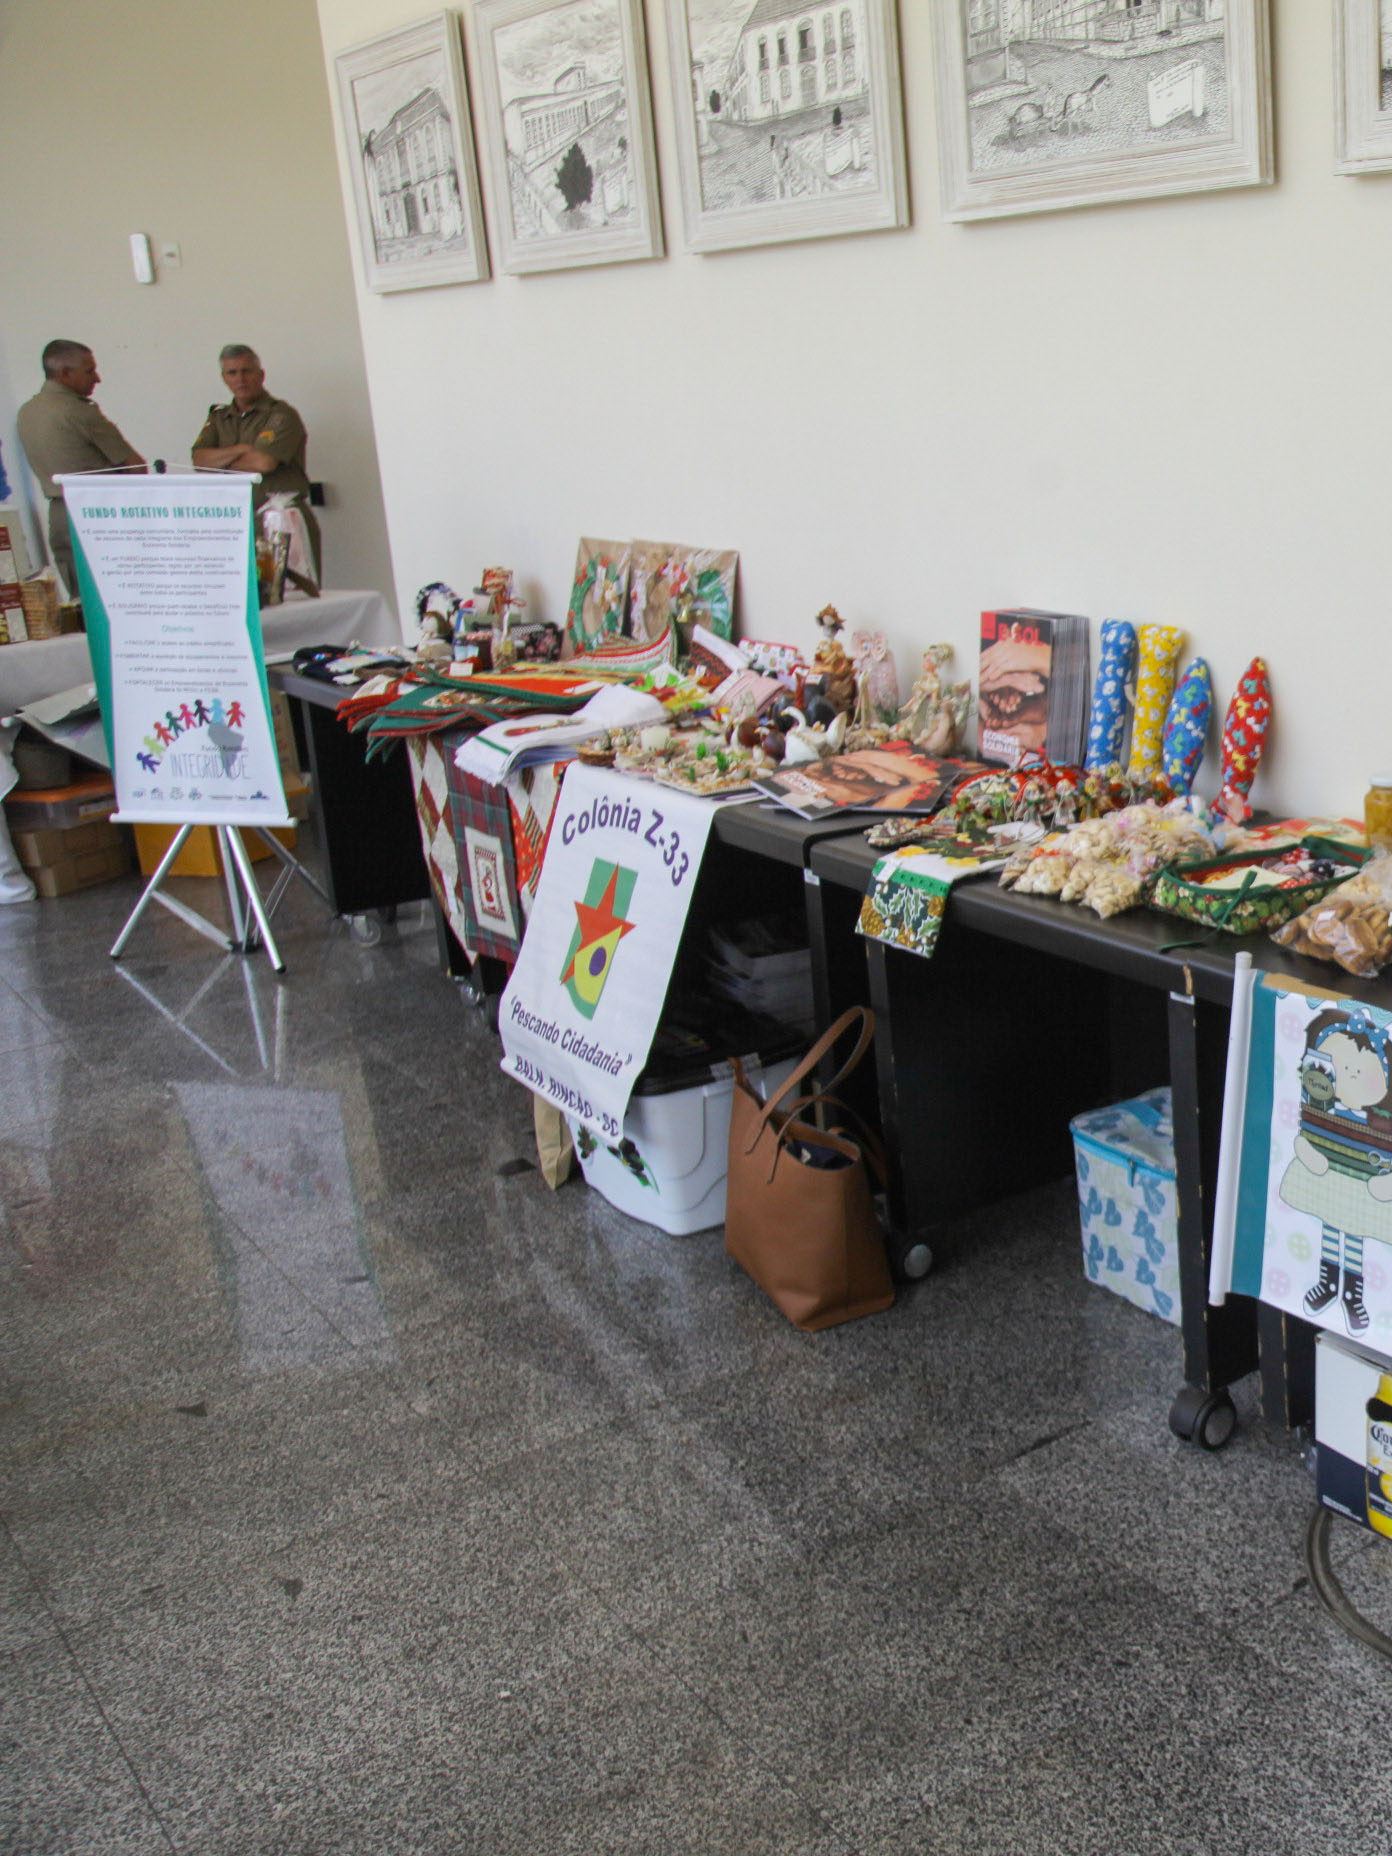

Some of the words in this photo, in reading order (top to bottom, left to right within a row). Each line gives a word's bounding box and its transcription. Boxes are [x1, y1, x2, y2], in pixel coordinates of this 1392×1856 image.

[82, 506, 117, 519] FUNDO
[121, 506, 169, 519] ROTATIVO
[173, 506, 242, 519] INTEGRIDADE
[562, 795, 642, 846] Colônia
[644, 808, 689, 887] Z-33
[602, 1112, 619, 1137] SC
